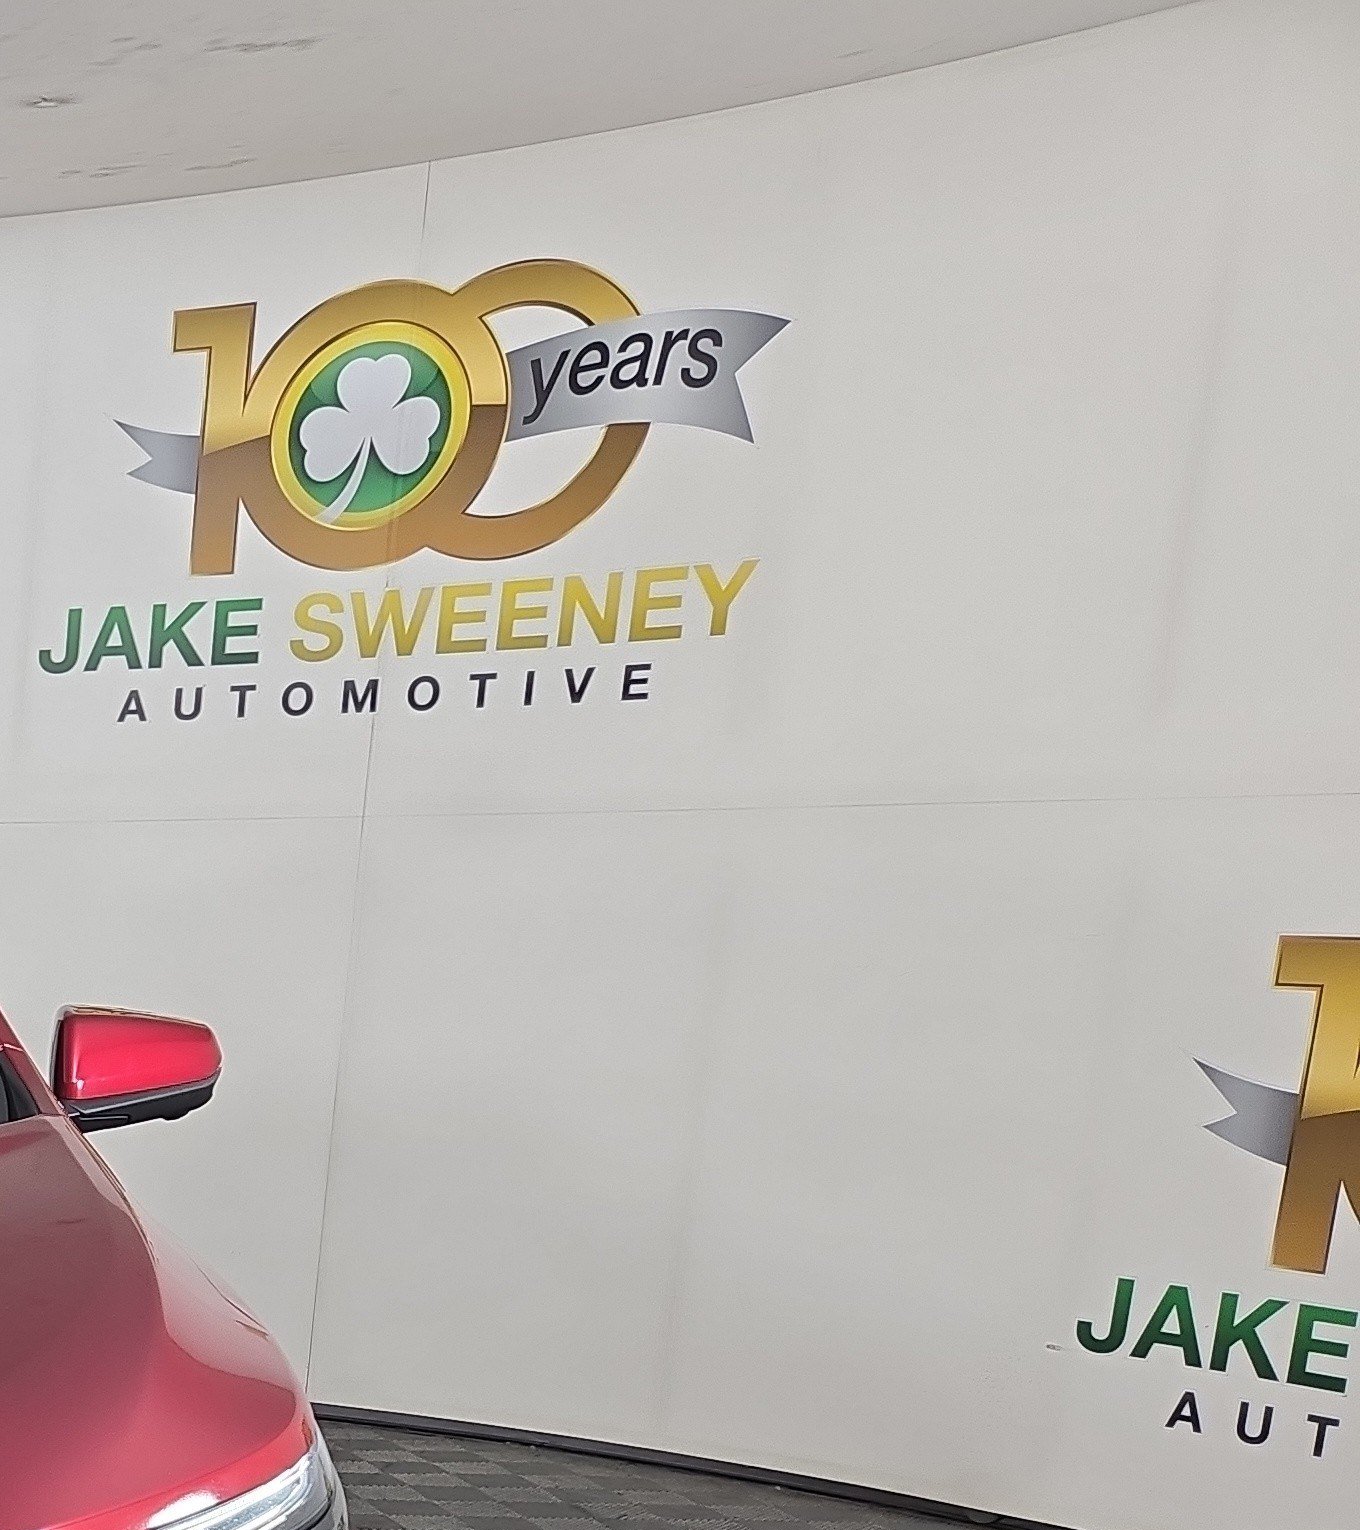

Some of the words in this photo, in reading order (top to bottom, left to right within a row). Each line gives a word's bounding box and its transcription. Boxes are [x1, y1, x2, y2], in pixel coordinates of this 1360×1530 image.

[172, 258, 652, 575] 100
[522, 328, 723, 425] years
[38, 597, 263, 673] JAKE
[290, 559, 760, 662] SWEENEY
[116, 663, 653, 723] AUTOMOTIVE
[1075, 1277, 1358, 1394] JAKE
[1164, 1391, 1340, 1458] AUT
